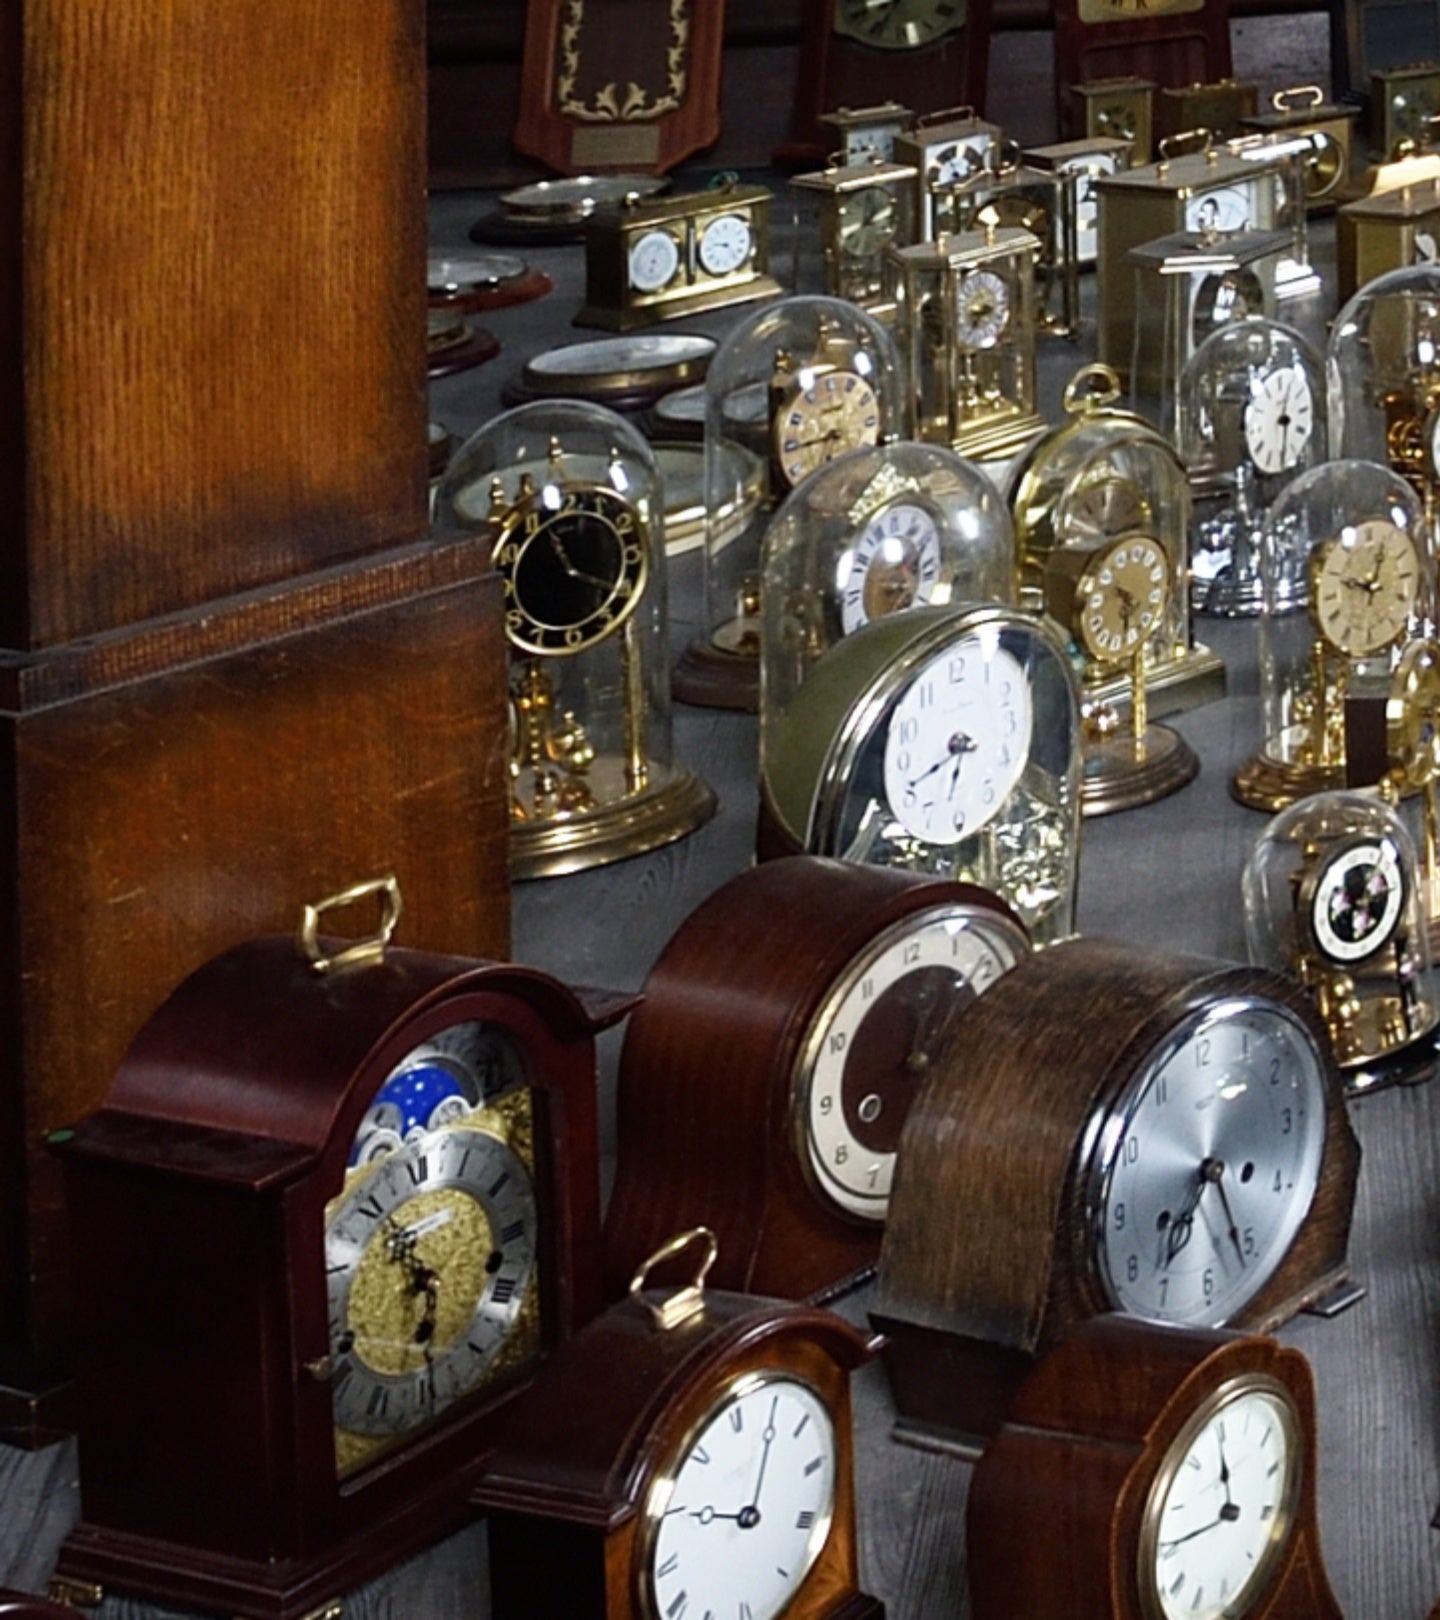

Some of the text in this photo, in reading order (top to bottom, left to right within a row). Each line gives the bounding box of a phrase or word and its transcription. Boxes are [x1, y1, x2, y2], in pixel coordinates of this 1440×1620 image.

[615, 513, 633, 535] 2
[506, 609, 523, 629] 8
[528, 628, 544, 647] 7
[949, 656, 966, 683] 12
[984, 661, 990, 684] 1
[919, 682, 934, 709] 11
[999, 681, 1011, 708] 2
[899, 716, 918, 746] 10
[922, 801, 934, 830] 7
[903, 942, 920, 965] 12
[981, 958, 993, 981] 2
[861, 977, 873, 999] 11
[829, 1031, 846, 1055] 10
[1195, 1038, 1211, 1068] 12
[1269, 1058, 1281, 1086] 2
[1155, 1077, 1167, 1106] 11
[820, 1095, 832, 1116] 9
[1281, 1107, 1292, 1135] 3
[834, 1145, 848, 1165] 8
[1121, 1136, 1138, 1167] 10
[868, 1166, 879, 1189] 7
[1272, 1169, 1282, 1193] 4
[1114, 1203, 1125, 1230] 9
[1244, 1227, 1255, 1255] 5
[1127, 1255, 1139, 1283] 8
[1203, 1269, 1214, 1296] 6
[1158, 1278, 1169, 1308] 7
